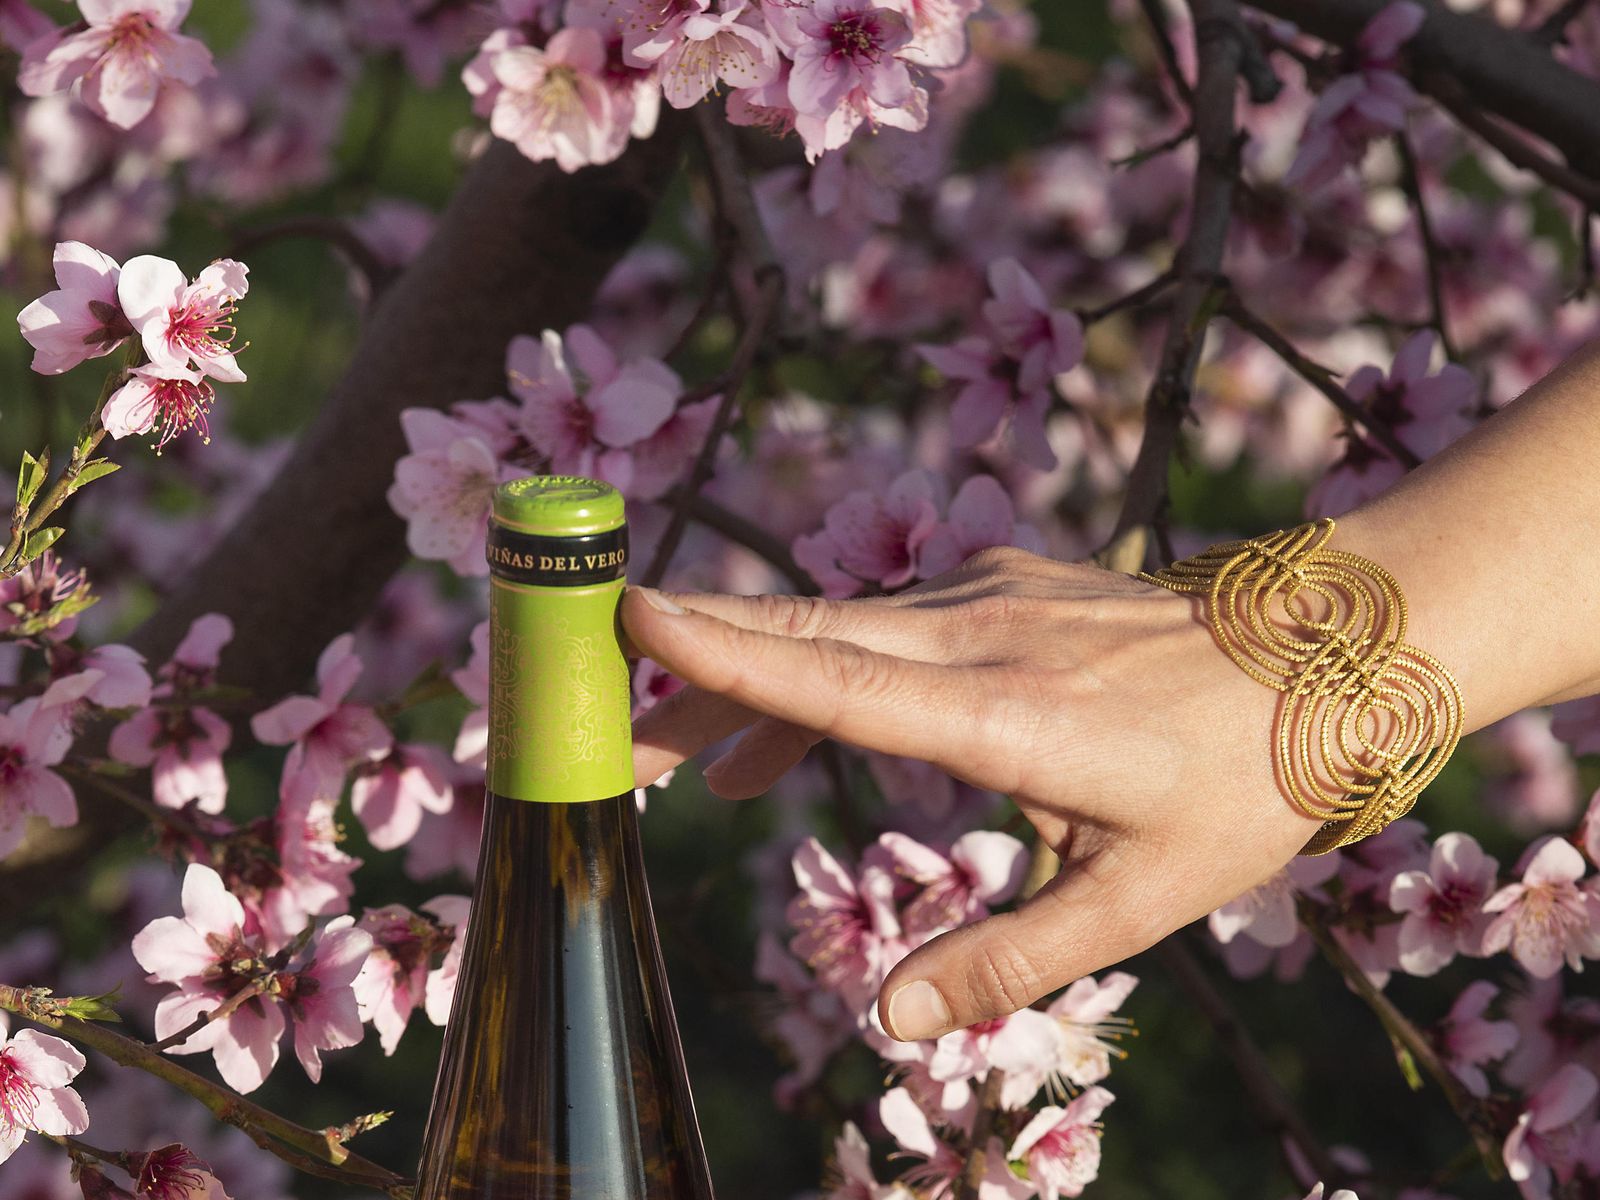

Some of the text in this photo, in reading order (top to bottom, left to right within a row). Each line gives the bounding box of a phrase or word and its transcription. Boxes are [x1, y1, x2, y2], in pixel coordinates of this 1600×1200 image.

[487, 543, 625, 571] VIÑAS DEL VERO
